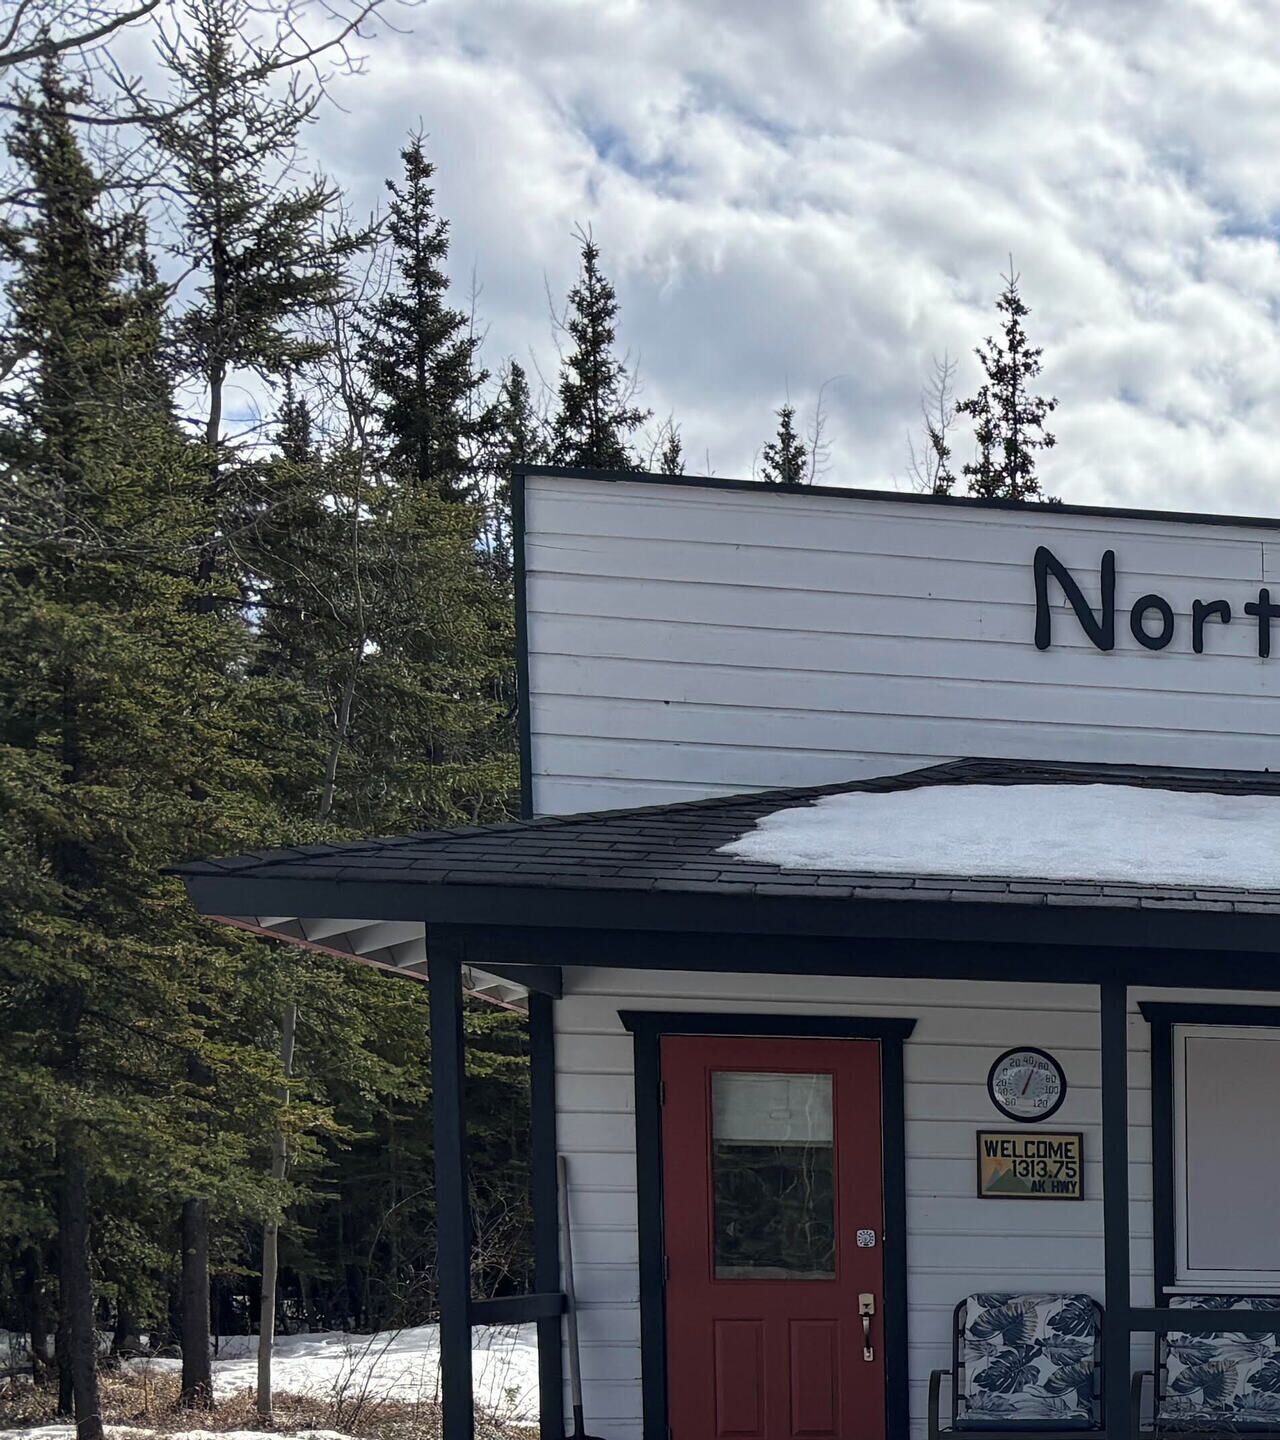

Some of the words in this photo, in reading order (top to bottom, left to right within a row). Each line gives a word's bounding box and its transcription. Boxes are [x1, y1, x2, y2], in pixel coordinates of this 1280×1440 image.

[1009, 1057, 1021, 1068] 20
[1023, 1056, 1034, 1065] 40
[1038, 1062, 1049, 1071] 60
[1045, 1074, 1057, 1083] 80
[1044, 1086, 1059, 1095] 100
[1033, 1099, 1048, 1108] 120
[984, 1139, 1075, 1160] WELCOME
[1011, 1159, 1077, 1179] 1313.75
[1031, 1179, 1046, 1193] AK
[1051, 1179, 1078, 1194] HWY
